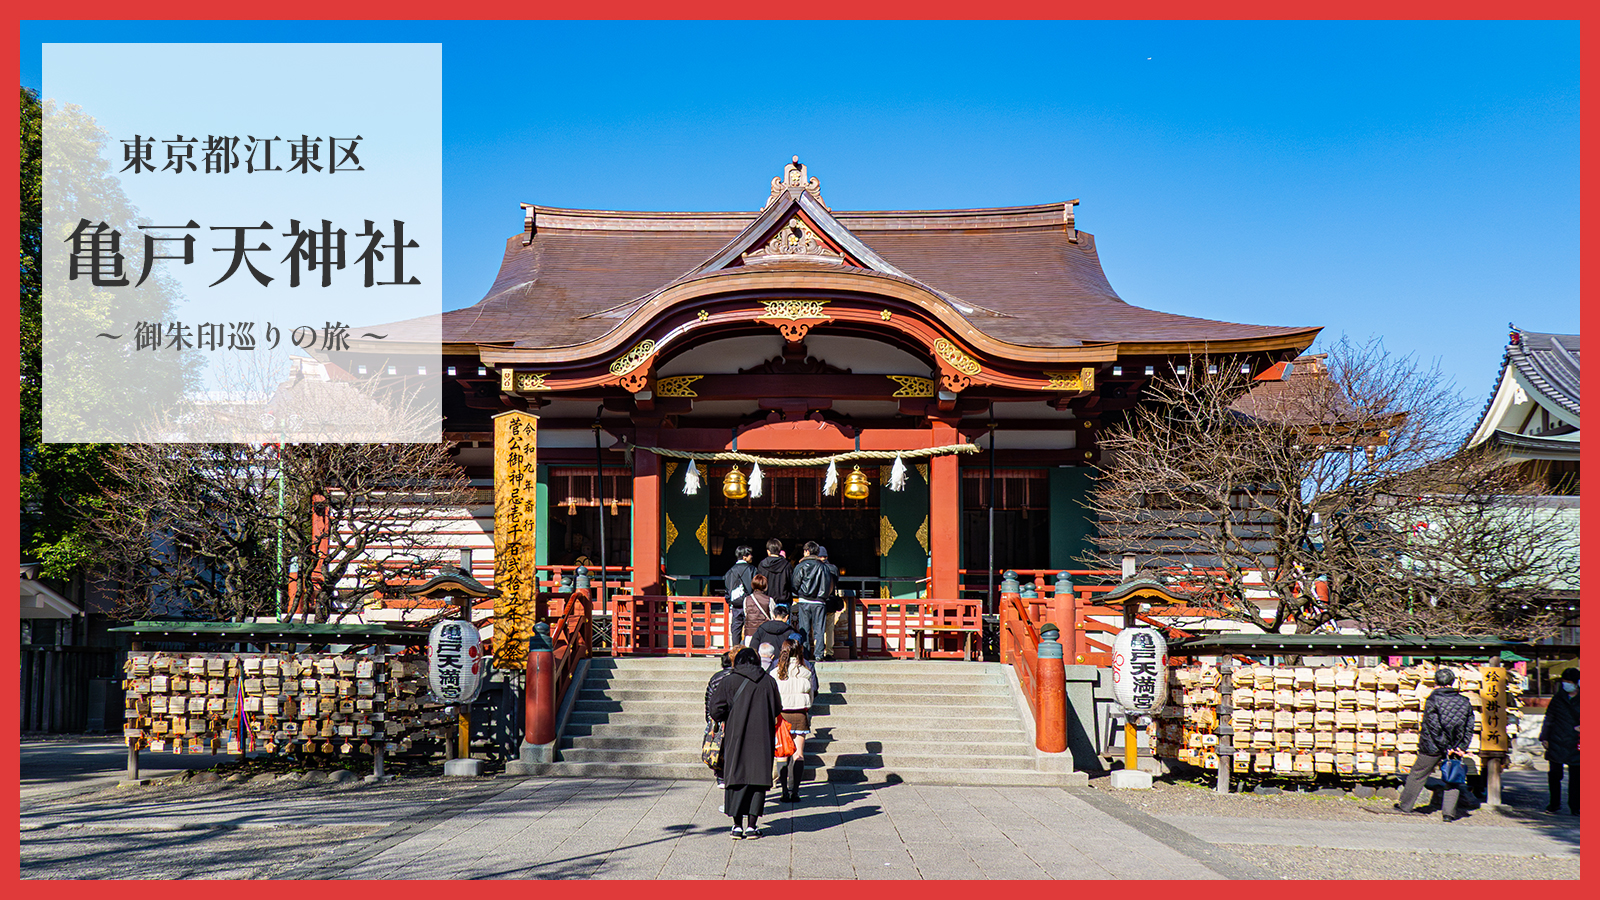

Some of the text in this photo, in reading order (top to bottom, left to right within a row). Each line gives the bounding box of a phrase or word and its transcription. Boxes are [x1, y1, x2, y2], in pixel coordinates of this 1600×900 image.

[1485, 671, 1501, 745] 絵馬掛け所
